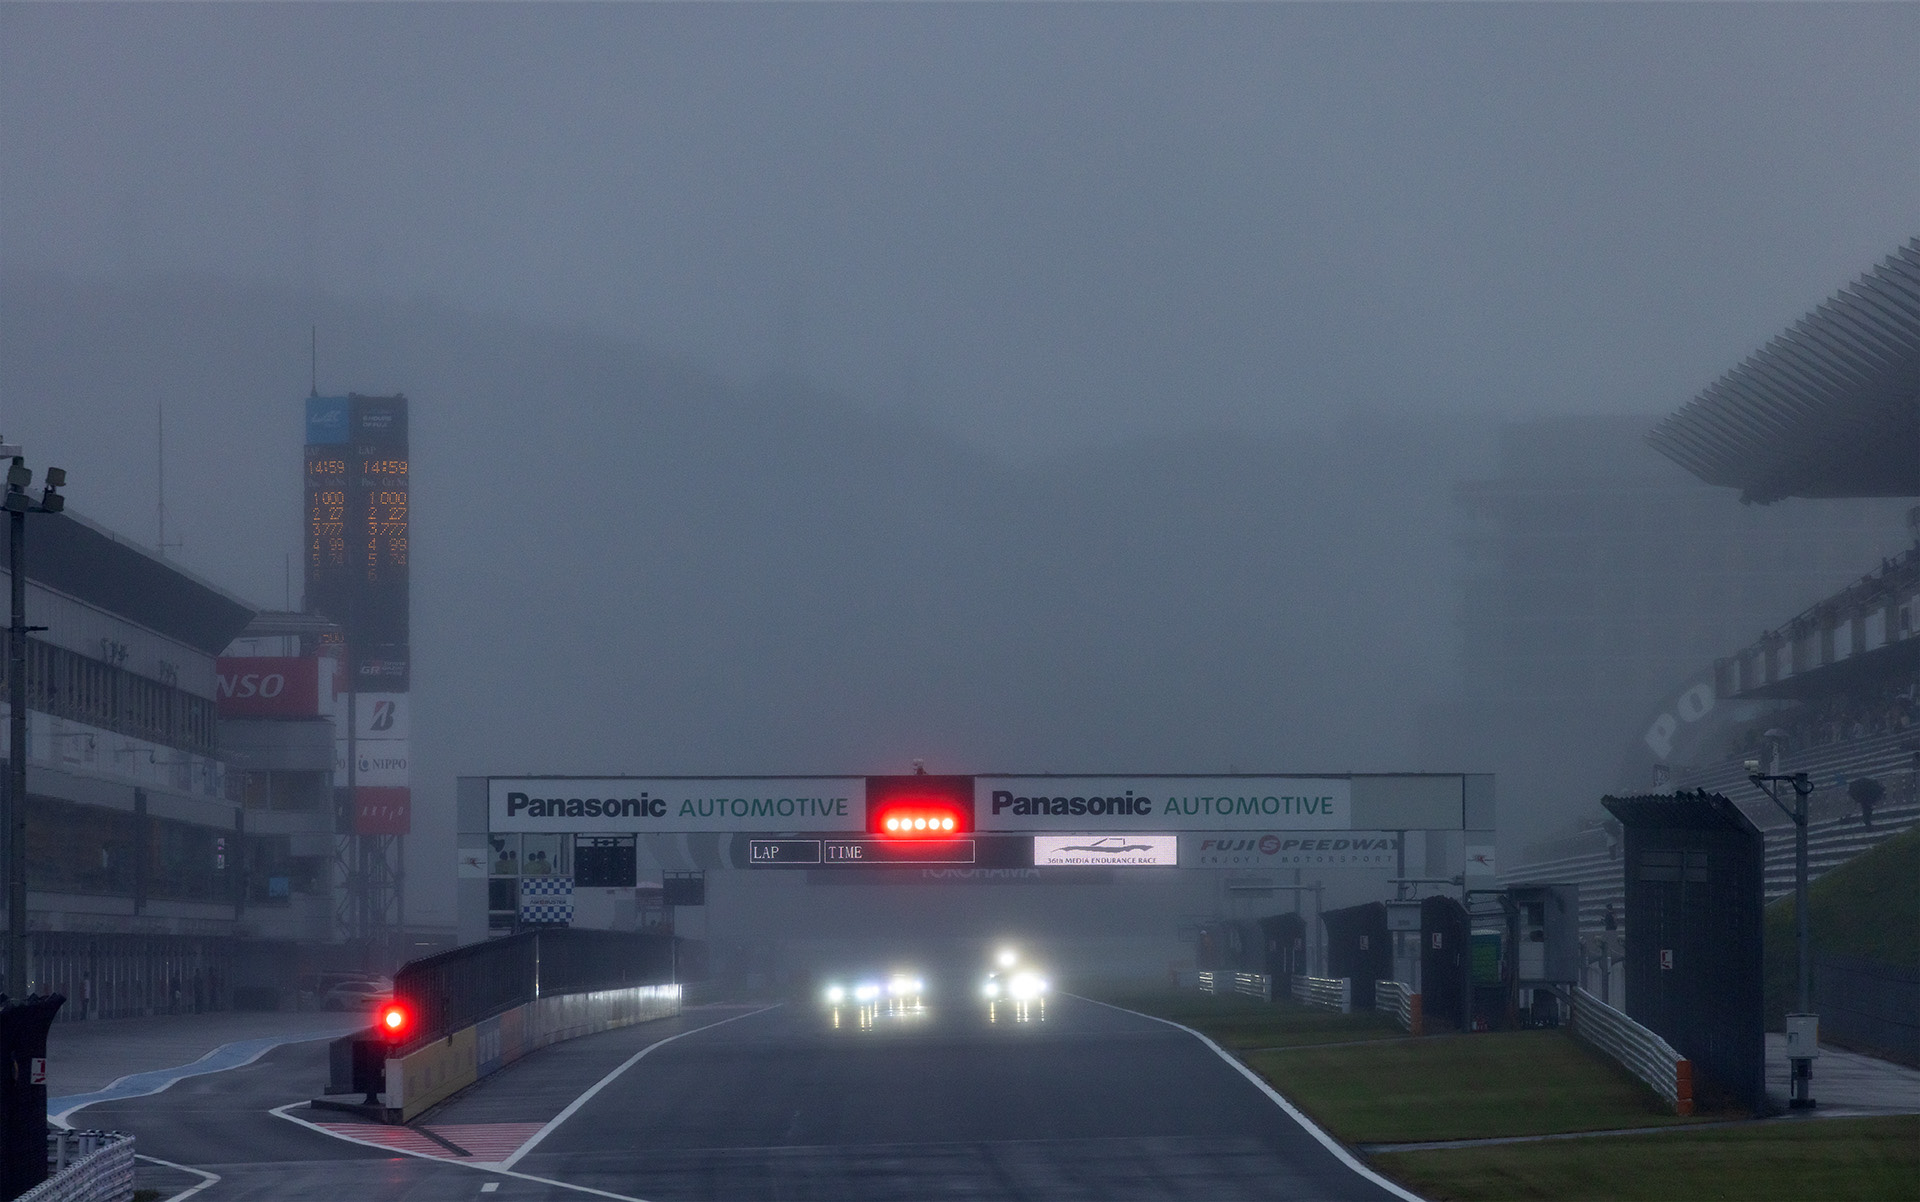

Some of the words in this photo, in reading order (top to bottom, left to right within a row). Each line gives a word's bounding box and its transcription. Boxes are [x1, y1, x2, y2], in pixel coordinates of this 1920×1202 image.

[309, 461, 345, 474] 14:59
[363, 460, 408, 475] 14:59
[313, 491, 320, 505] 1
[368, 491, 377, 505] 1
[313, 507, 320, 520] 2
[368, 507, 377, 520] 2
[389, 507, 407, 520] 27
[313, 522, 320, 536] 3
[322, 522, 344, 536] 777
[368, 522, 377, 536] 3
[380, 522, 407, 536] 777
[368, 537, 377, 551] 4
[372, 759, 407, 770] NIPPO
[507, 792, 667, 817] Panasonic
[678, 798, 848, 817] AUTOMOTIVE
[992, 790, 1152, 815] Panasonic
[1163, 796, 1333, 815] AUTOMOTIVE
[1201, 839, 1256, 851] FUJI
[753, 846, 779, 859] LAP
[828, 846, 863, 859] TIME
